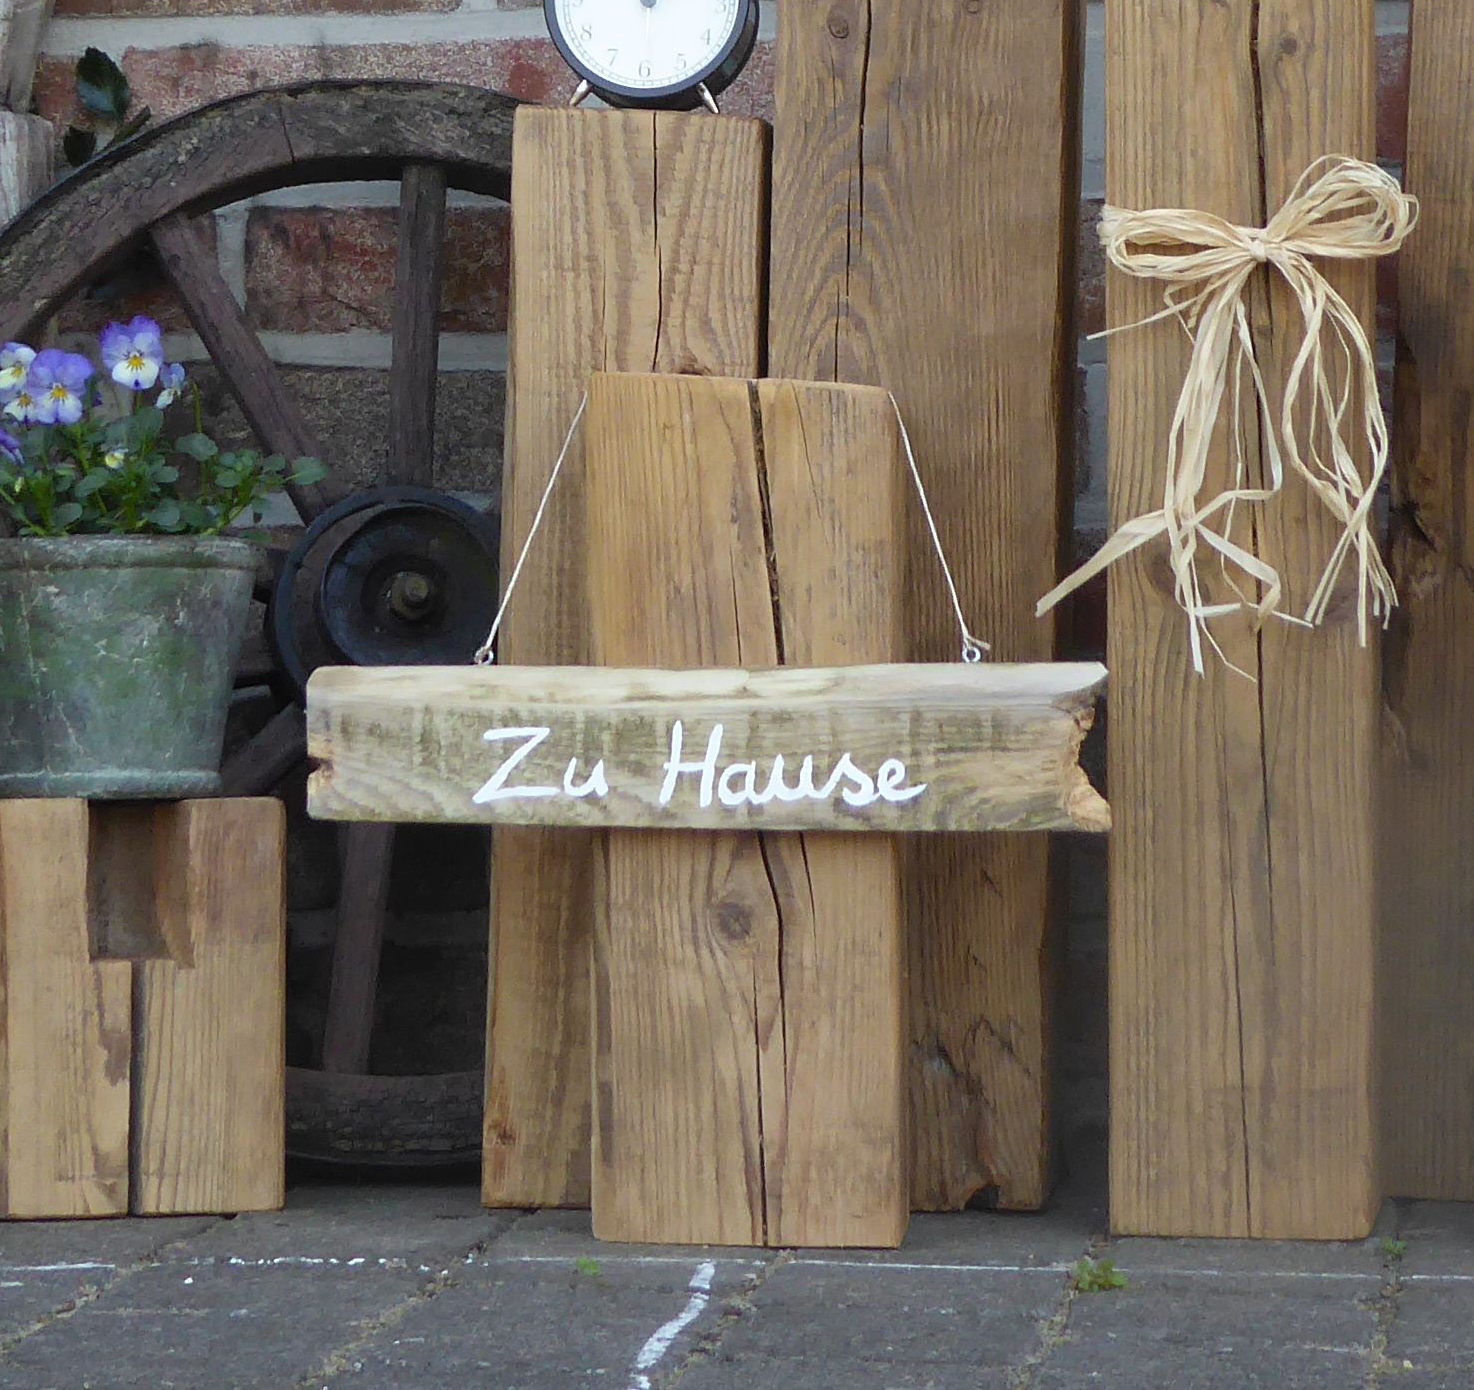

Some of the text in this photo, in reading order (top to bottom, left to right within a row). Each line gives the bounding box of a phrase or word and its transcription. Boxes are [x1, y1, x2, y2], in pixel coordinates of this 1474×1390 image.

[580, 24, 592, 42] 8
[700, 28, 711, 46] 4
[607, 48, 618, 67] 7
[677, 54, 687, 69] 5
[639, 63, 650, 78] 6
[472, 720, 926, 809] Zu Hause
